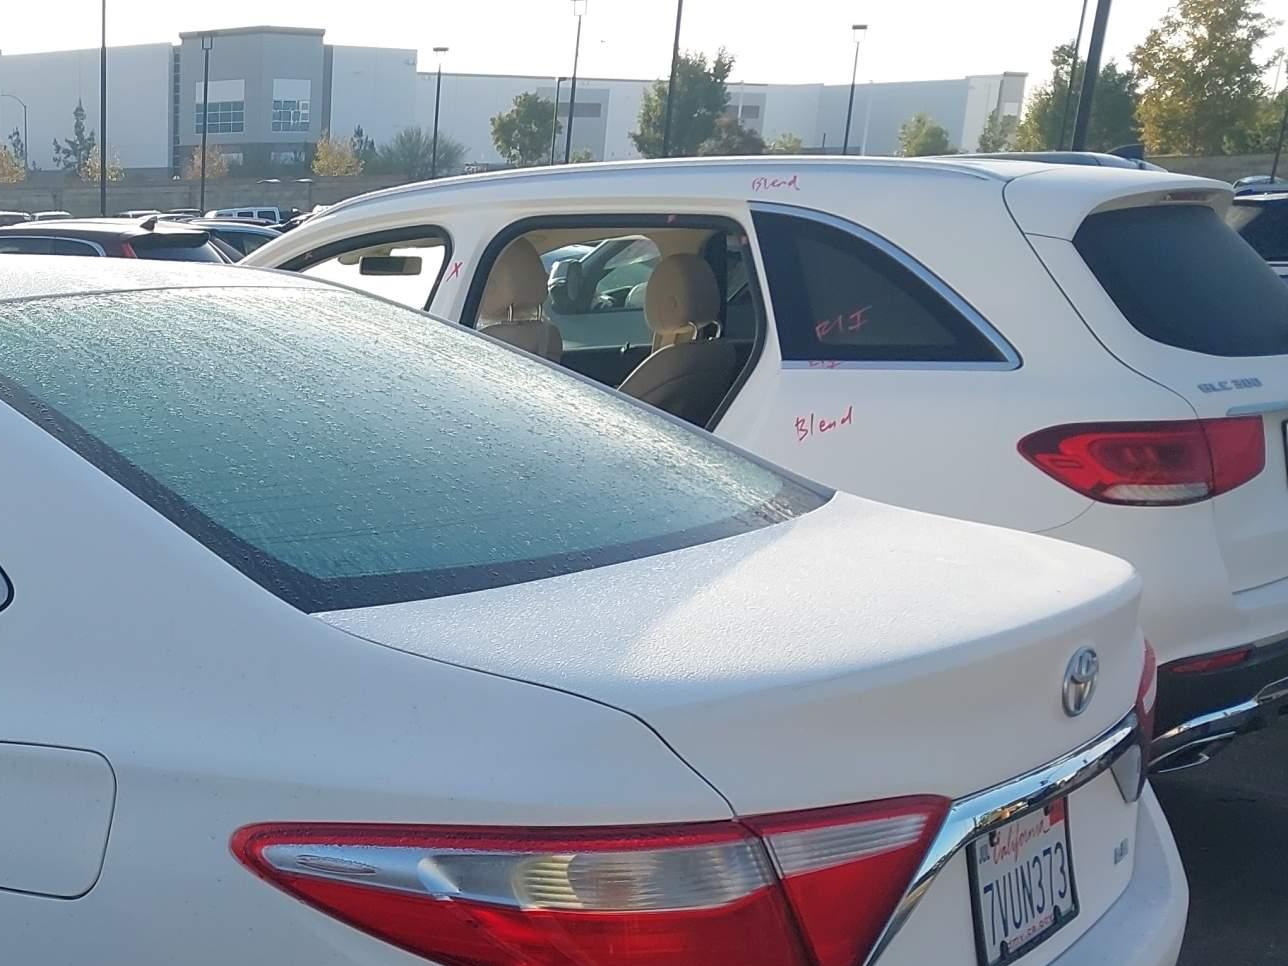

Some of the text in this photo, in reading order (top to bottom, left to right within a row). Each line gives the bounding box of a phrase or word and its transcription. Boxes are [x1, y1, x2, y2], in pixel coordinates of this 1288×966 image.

[795, 405, 853, 441] Blend
[993, 819, 1050, 865] California
[983, 841, 1068, 946] 7VUN373
